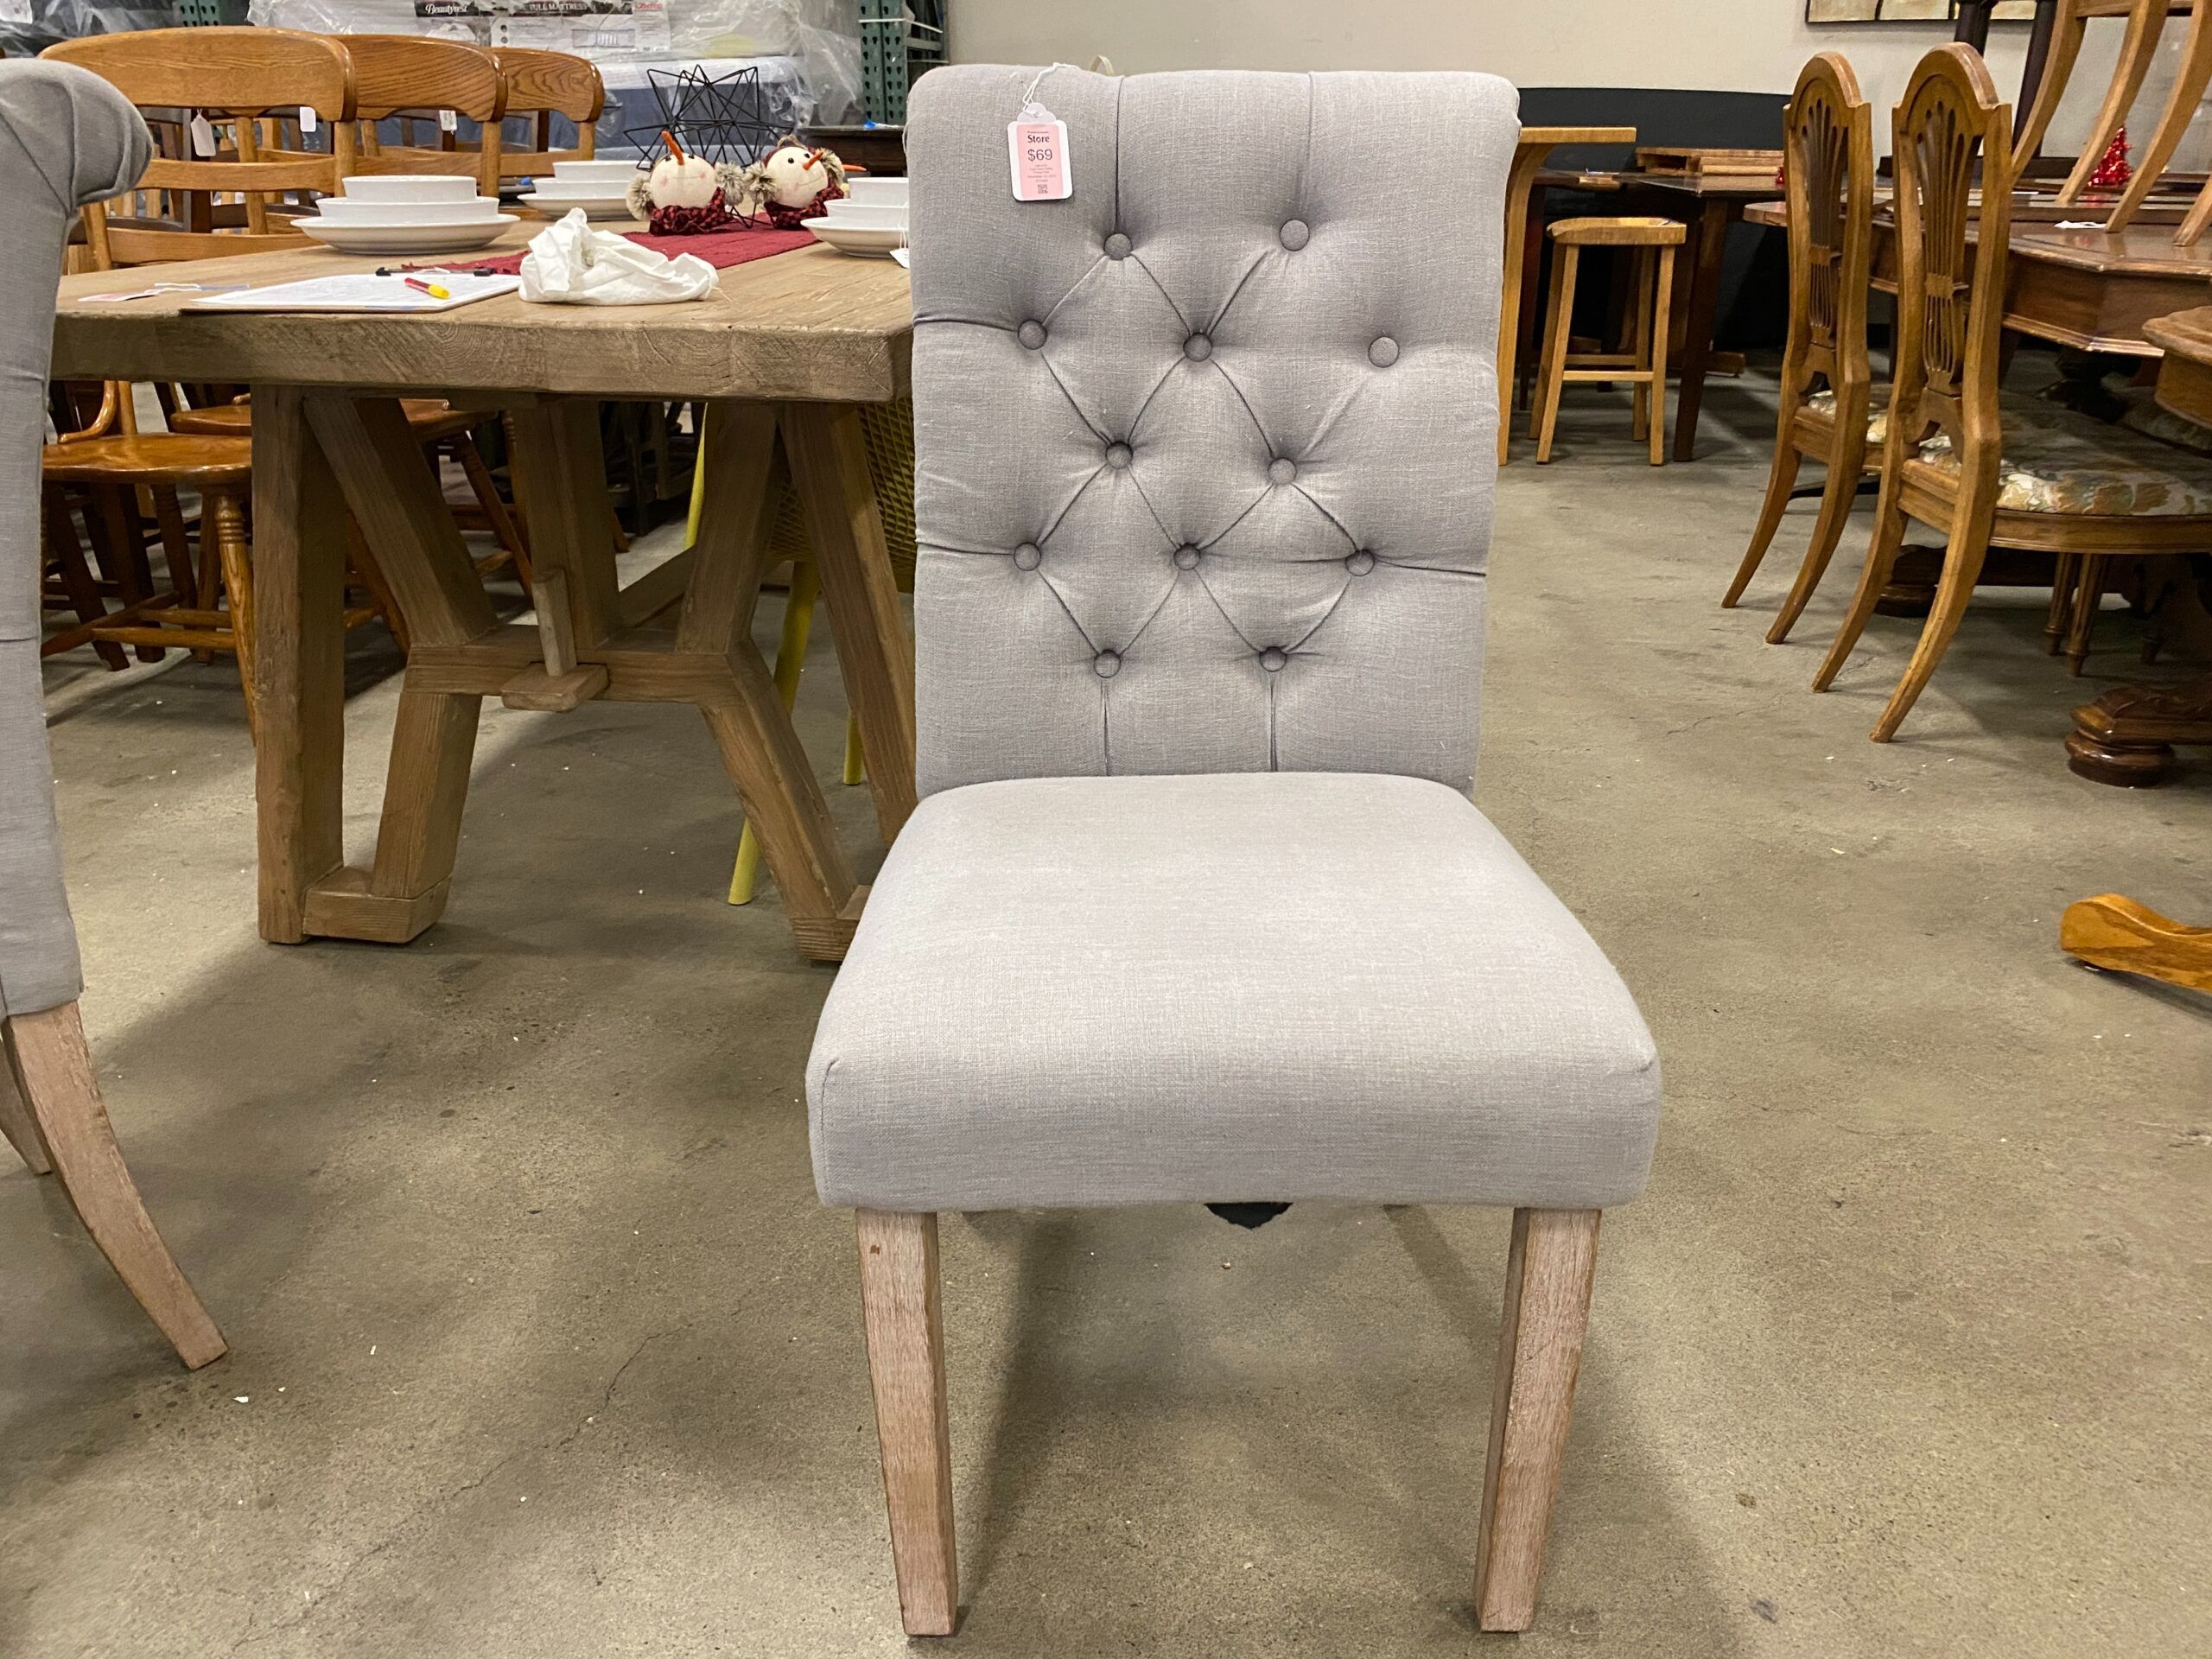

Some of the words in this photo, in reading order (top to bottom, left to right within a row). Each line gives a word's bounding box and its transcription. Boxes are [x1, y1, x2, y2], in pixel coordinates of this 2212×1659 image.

[425, 3, 467, 15] Beautyrest
[1027, 134, 1050, 143] Store
[1027, 149, 1052, 162] $69
